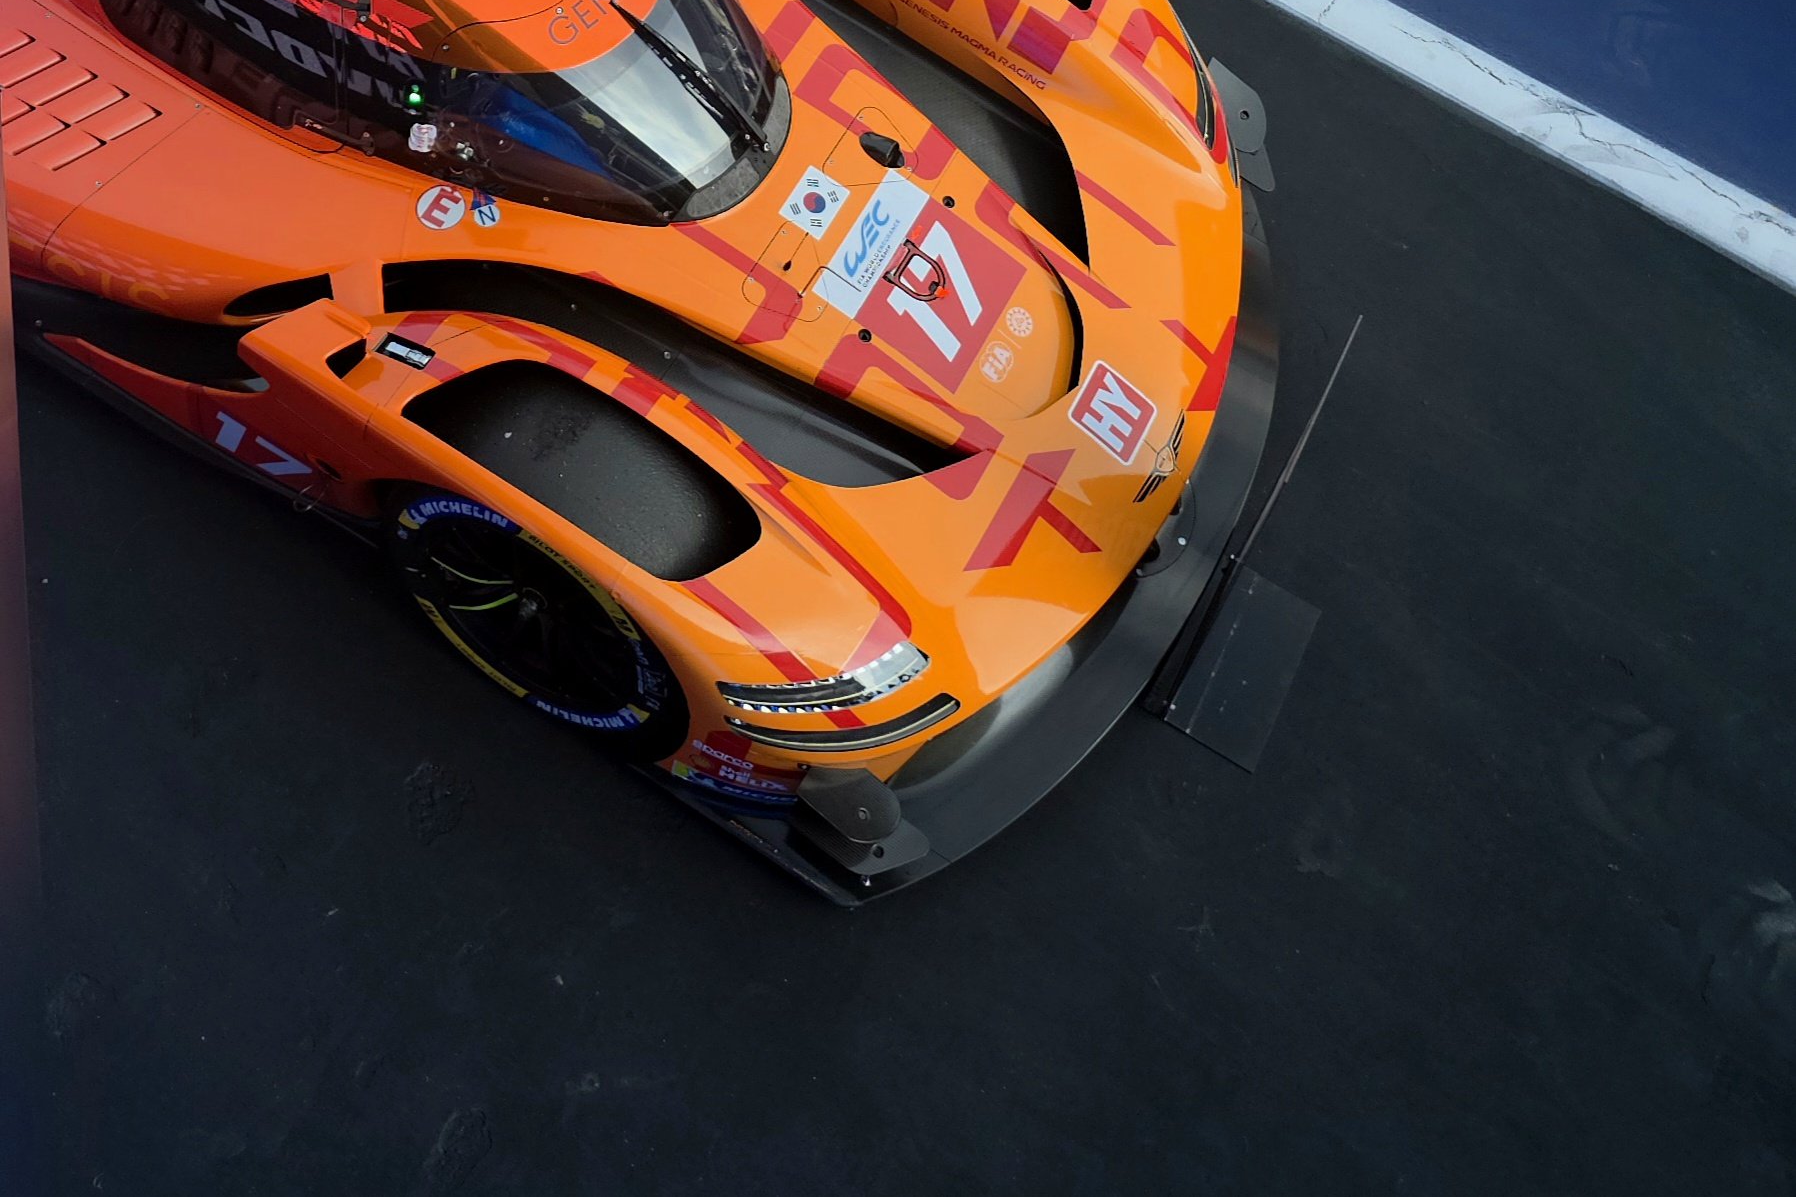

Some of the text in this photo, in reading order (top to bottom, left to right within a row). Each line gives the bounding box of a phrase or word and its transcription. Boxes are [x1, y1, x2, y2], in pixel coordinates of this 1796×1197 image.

[950, 27, 997, 61] MAGMA
[997, 57, 1047, 90] RACING
[844, 199, 890, 277] WEC
[886, 220, 983, 362] 17
[215, 411, 313, 476] 17
[1081, 371, 1142, 453] HY
[419, 500, 510, 528] MICHELIN
[535, 700, 623, 729] MICHELIN
